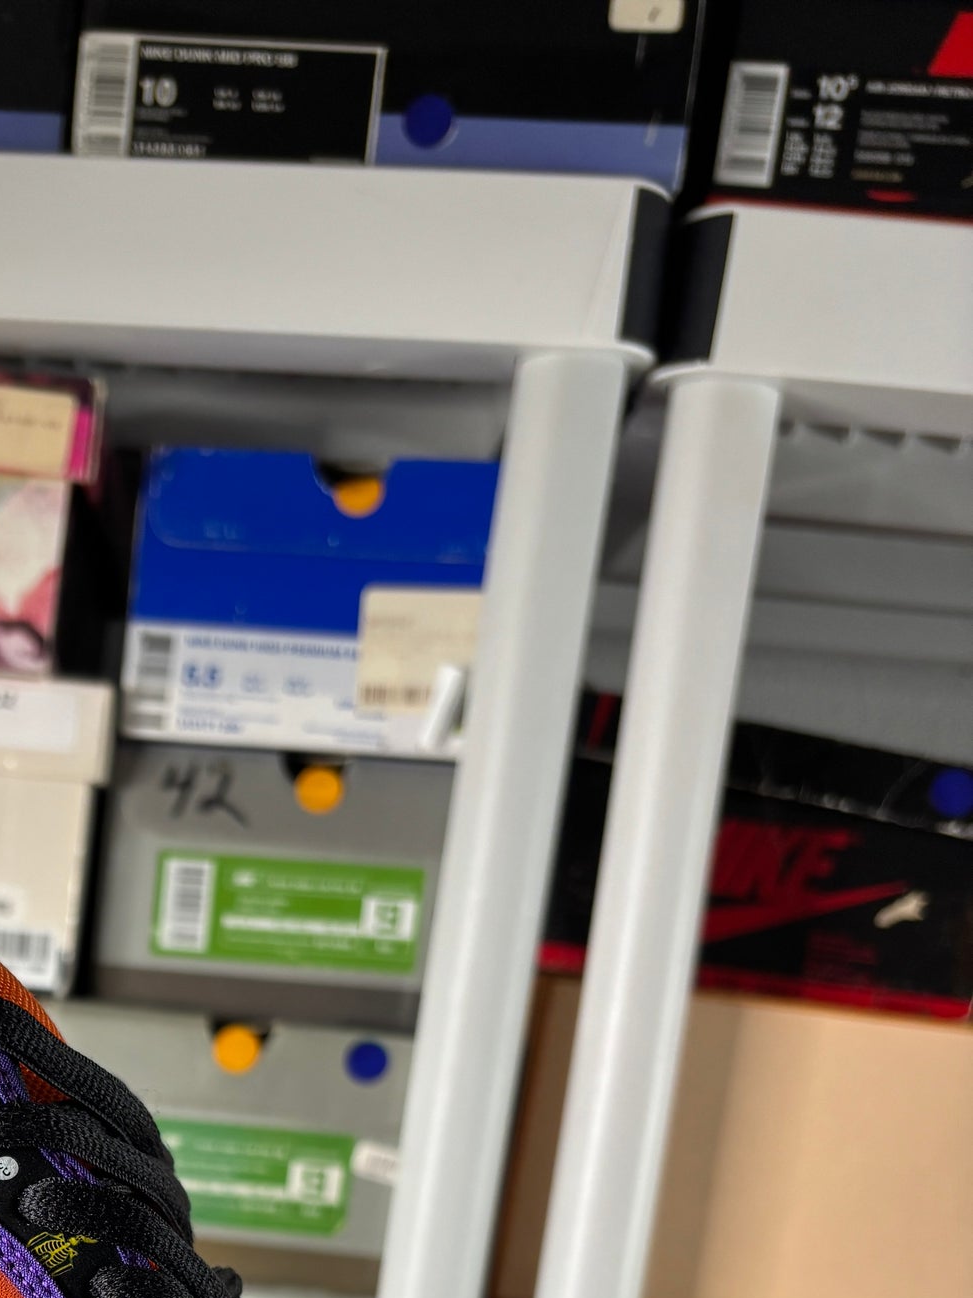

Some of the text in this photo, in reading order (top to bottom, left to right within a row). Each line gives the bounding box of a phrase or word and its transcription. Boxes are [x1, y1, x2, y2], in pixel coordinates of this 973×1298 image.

[140, 46, 173, 61] NIKE
[139, 77, 177, 107] 10
[812, 102, 844, 131] 12
[161, 757, 252, 829] 42
